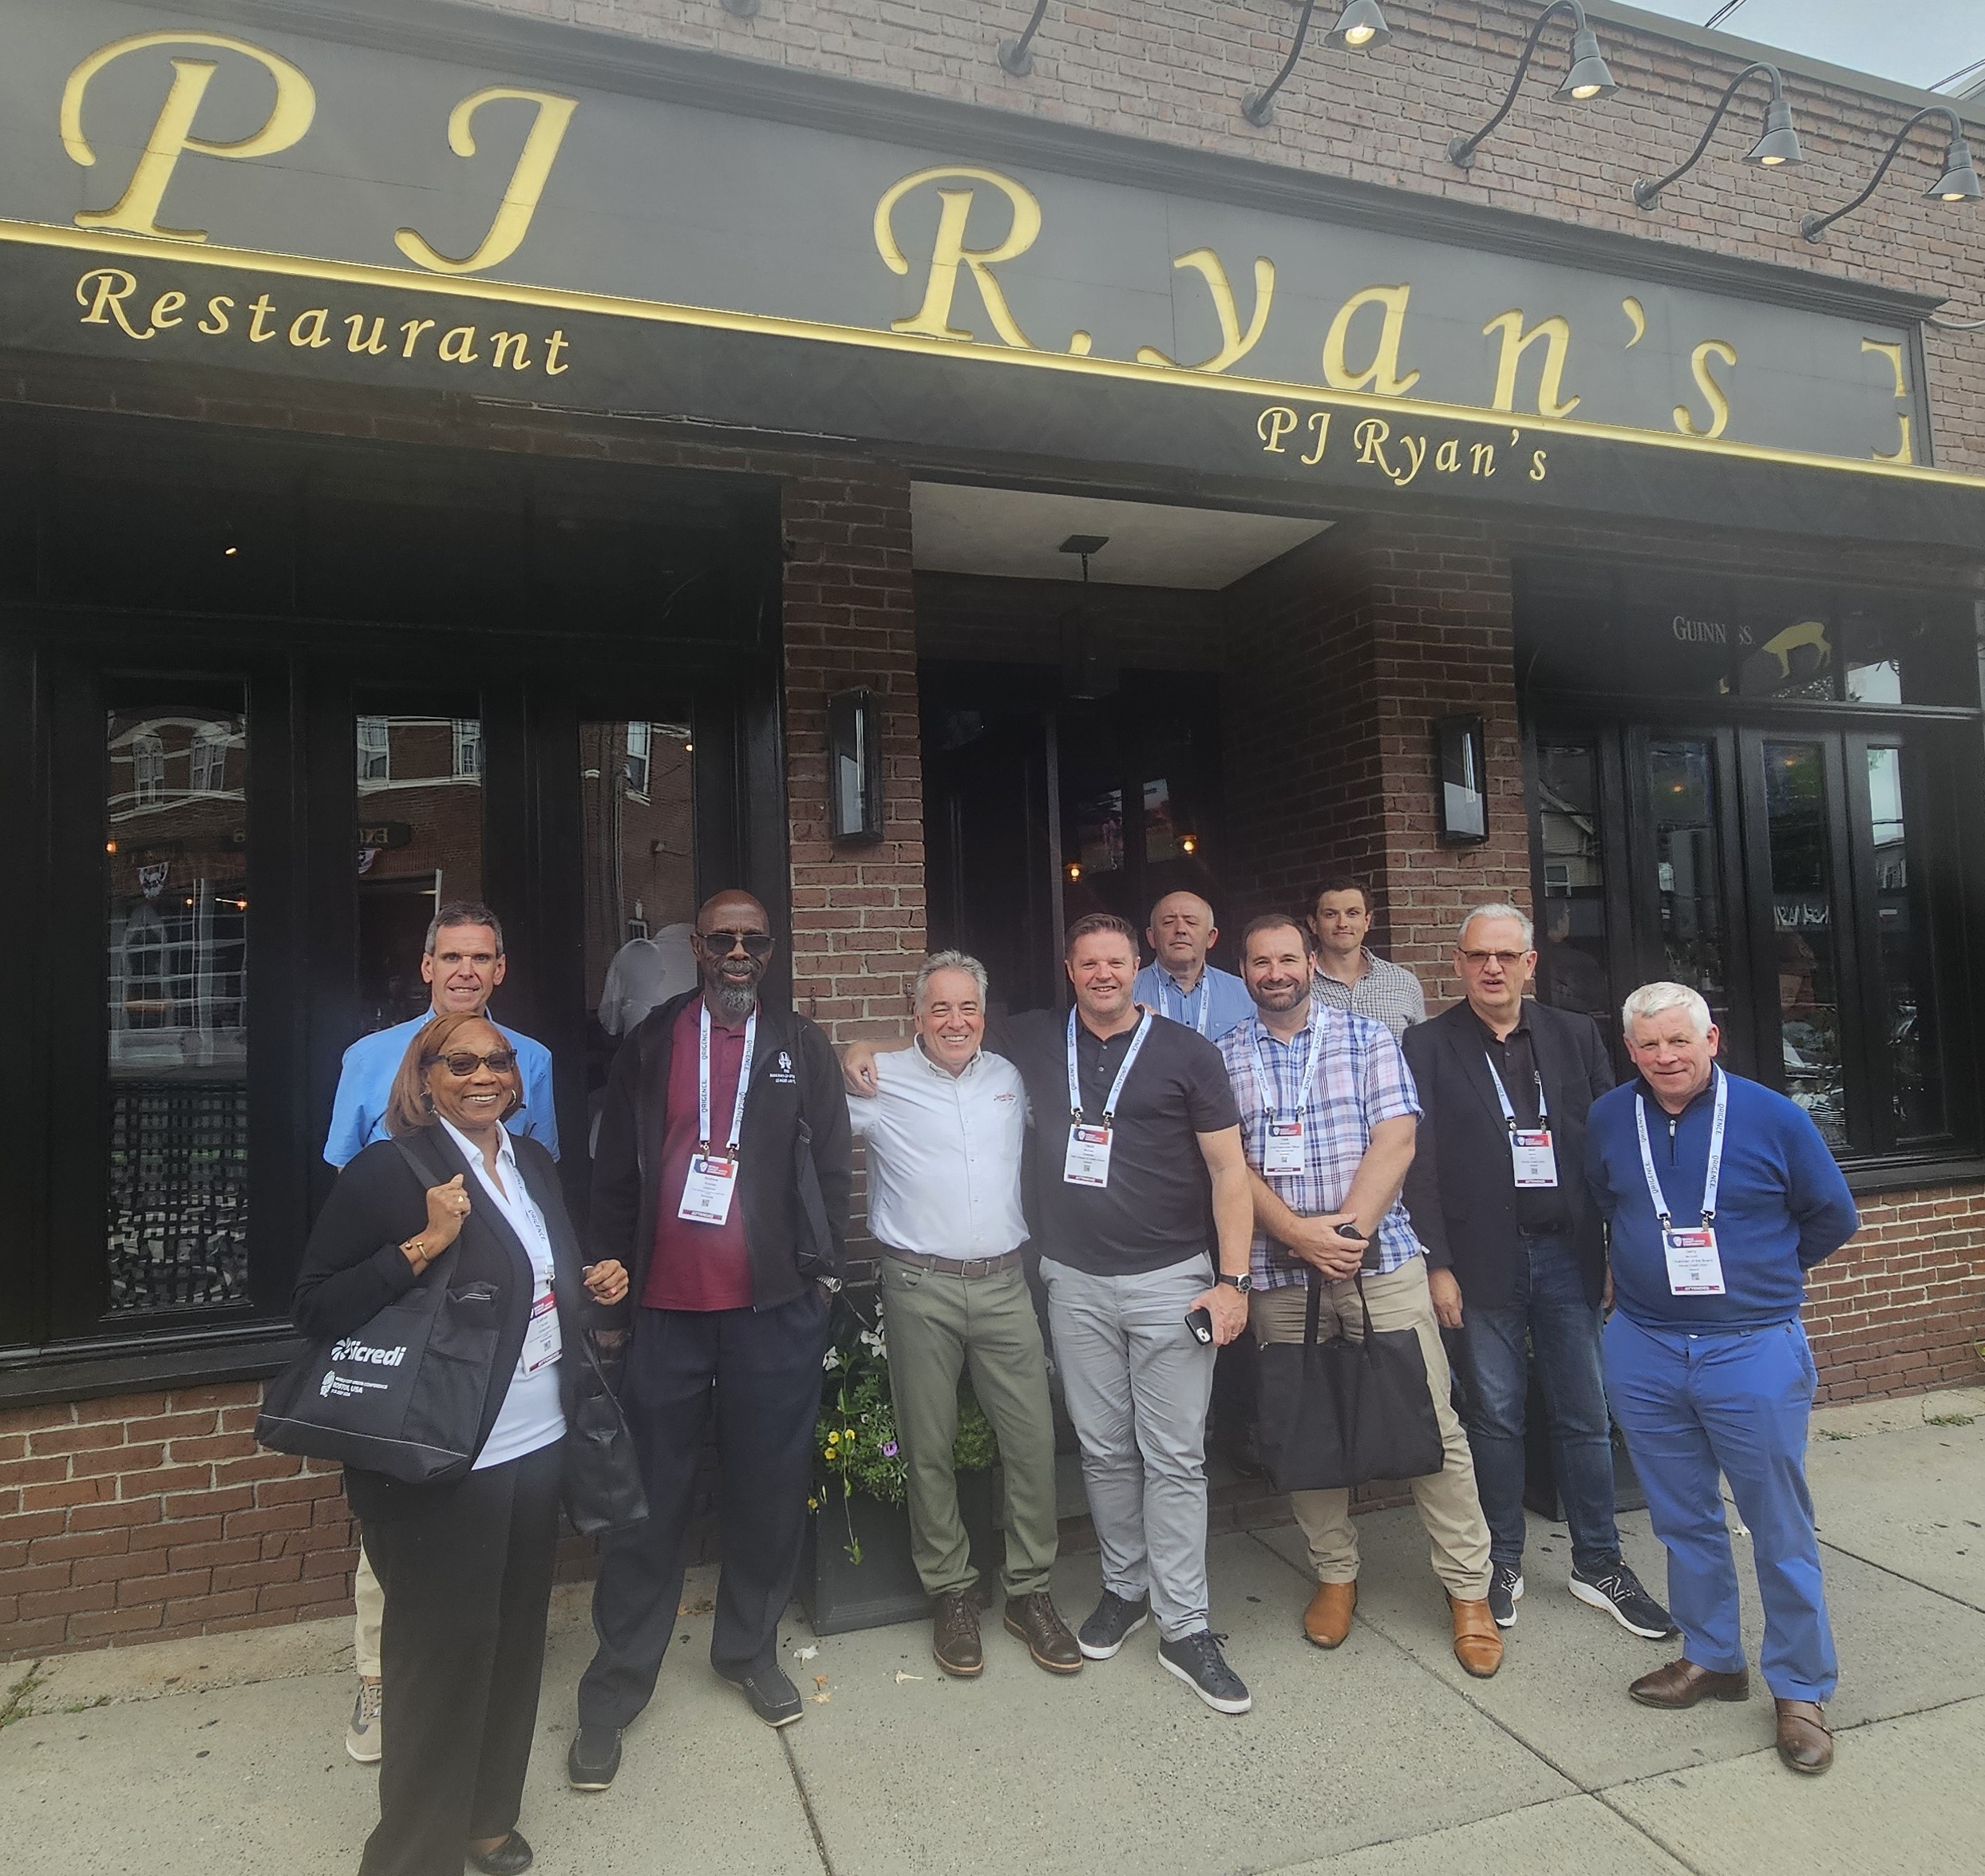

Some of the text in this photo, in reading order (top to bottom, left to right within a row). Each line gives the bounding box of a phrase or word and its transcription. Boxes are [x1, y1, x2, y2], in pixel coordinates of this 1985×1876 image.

[75, 267, 571, 376] Restaurant
[1257, 406, 1547, 487] PJ Ryan's
[1673, 615, 1753, 646] GUINNSS
